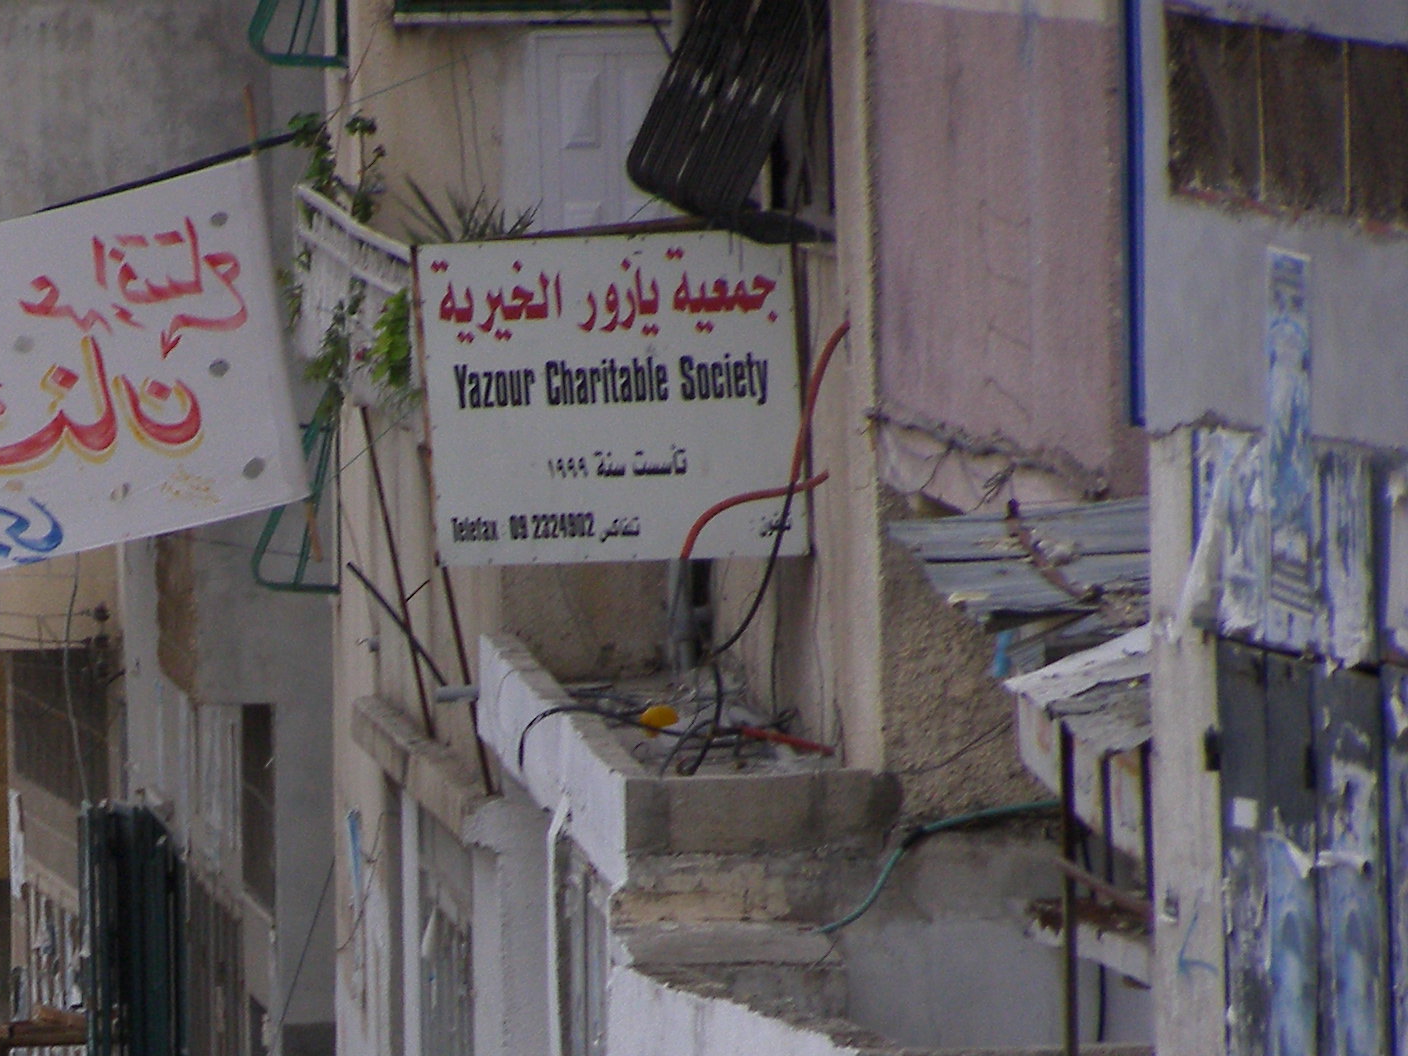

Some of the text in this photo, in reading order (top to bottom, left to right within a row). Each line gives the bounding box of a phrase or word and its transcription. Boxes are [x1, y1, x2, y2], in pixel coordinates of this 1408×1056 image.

[430, 247, 778, 343] جمعية يازور الخيرية
[454, 352, 769, 410] Yazour Charitable Society
[594, 450, 626, 477] سنة
[451, 517, 498, 542] Telefax
[509, 514, 530, 540] 09
